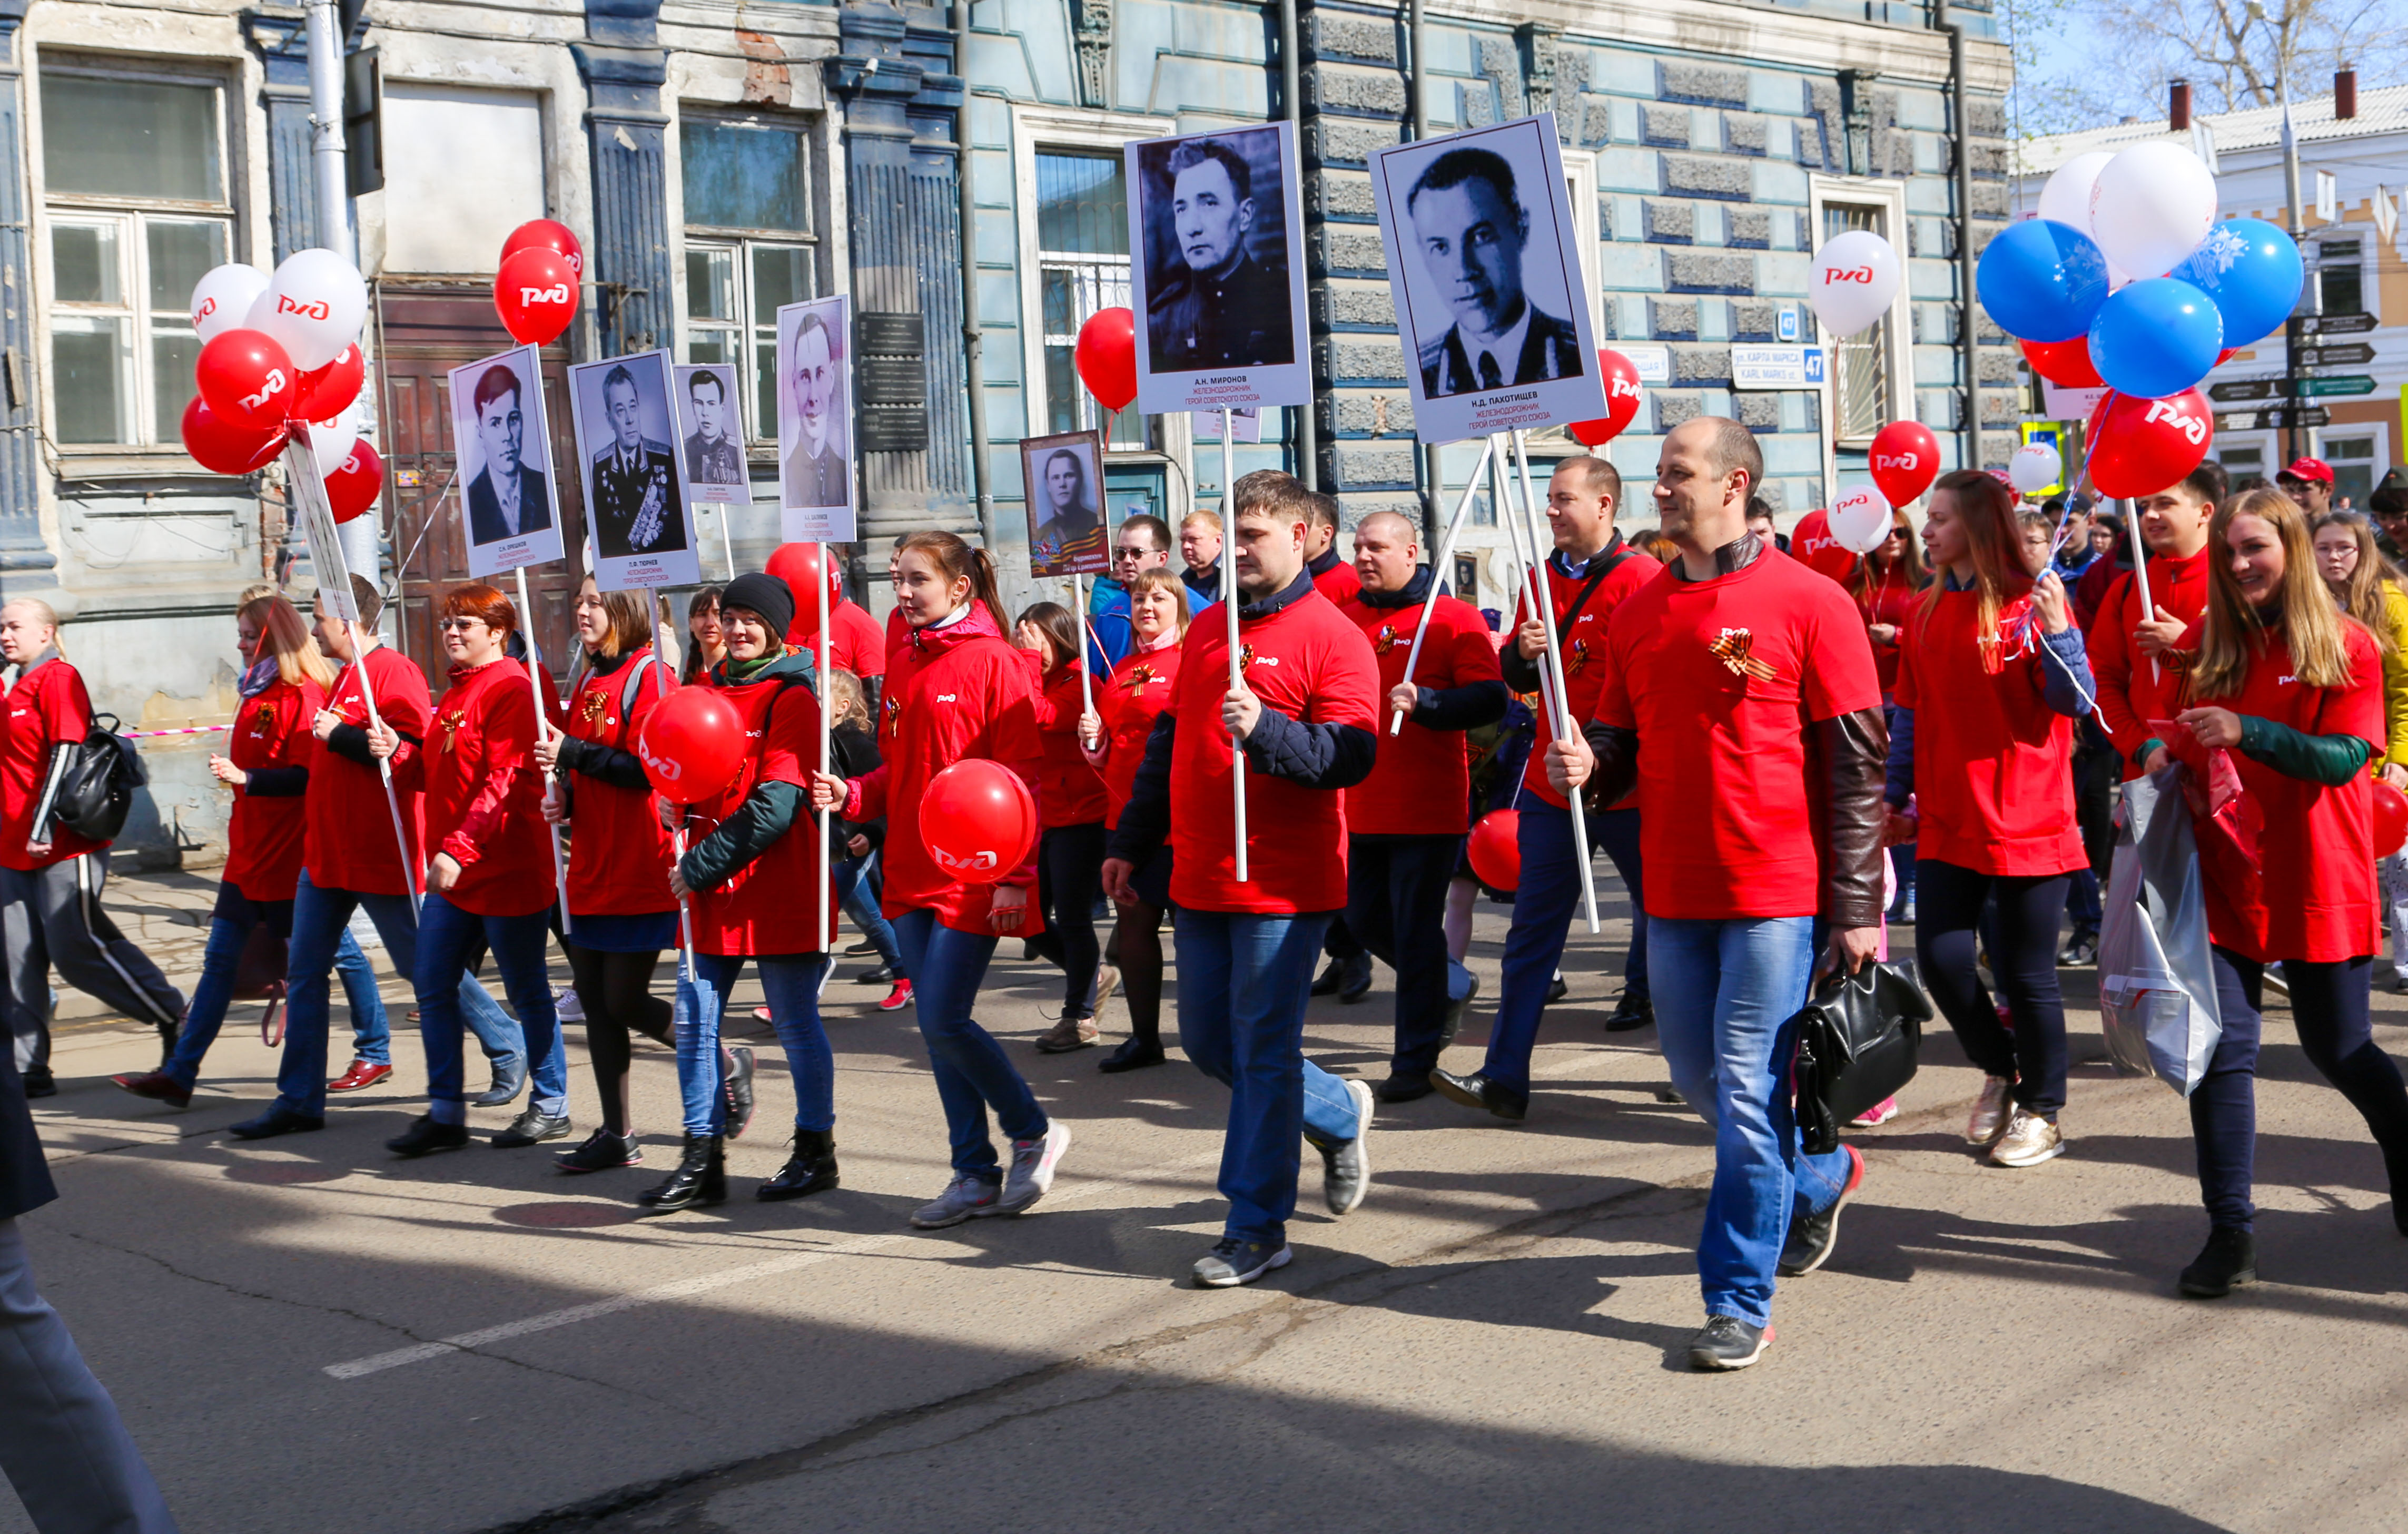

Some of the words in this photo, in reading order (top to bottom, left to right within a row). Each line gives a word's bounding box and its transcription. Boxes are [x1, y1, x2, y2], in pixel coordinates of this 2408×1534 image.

[1783, 317, 1794, 330] 47
[1748, 353, 1770, 363] КАРЛА
[1772, 353, 1799, 363] МАРКСА
[1805, 355, 1822, 376] 47
[1741, 369, 1760, 379] KARL
[1211, 376, 1247, 384] МИРОНОВ
[1193, 385, 1251, 395] ЖЕЛЕЗНОДОРОЖНИК
[1186, 396, 1202, 405] ГЕРОЙ
[1203, 395, 1238, 404] СОВЕТСКОГО
[1489, 391, 1537, 405] ПАХОТИЩЕВ
[1476, 402, 1539, 418] ЖЕЛЕЗНОДОРОЖНИК
[1469, 419, 1488, 430] ГЕРОЙ
[1489, 415, 1527, 427] СОВЕТСКОГО
[1528, 411, 1551, 421] СОЮЗА
